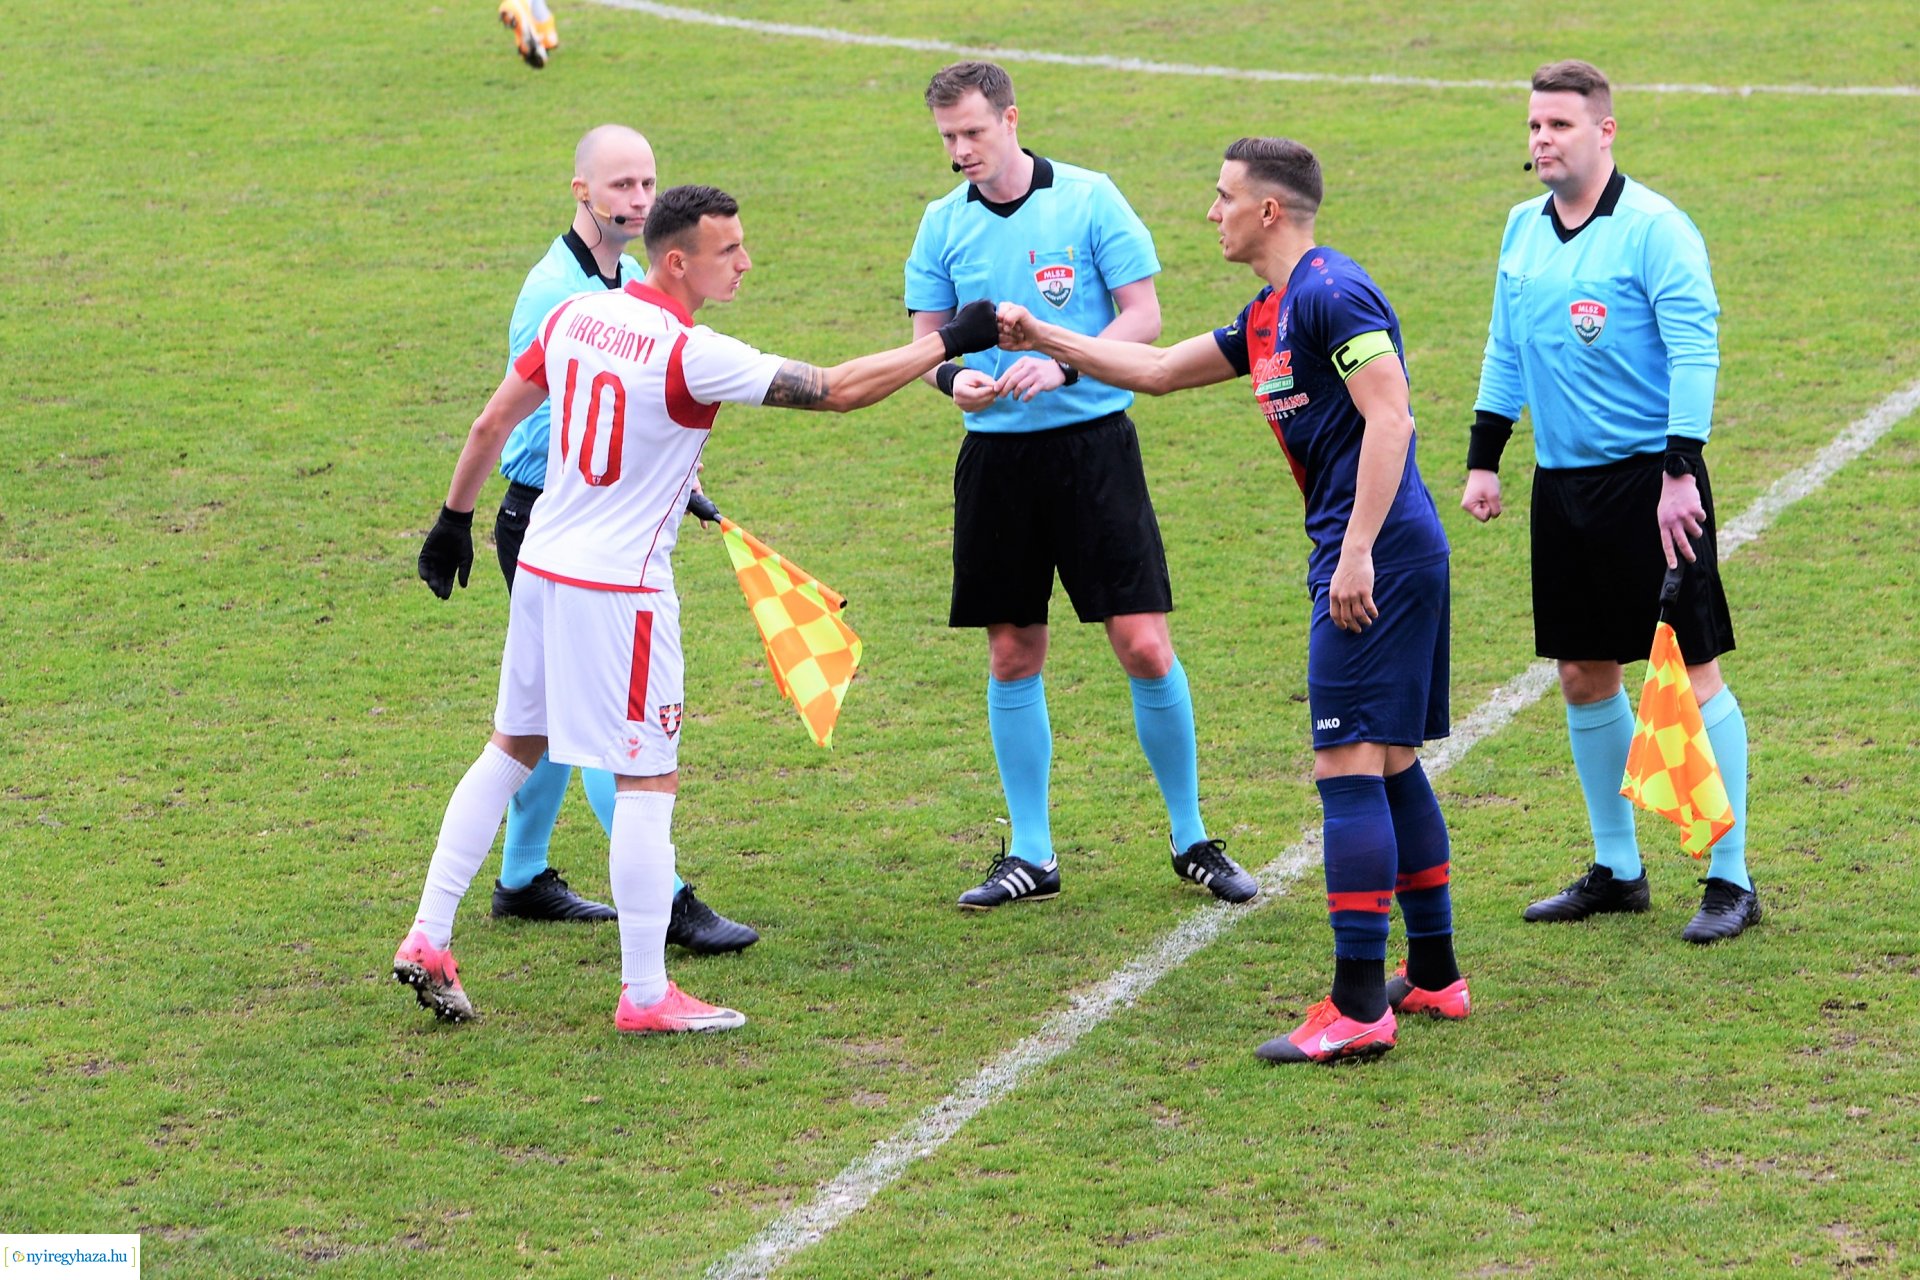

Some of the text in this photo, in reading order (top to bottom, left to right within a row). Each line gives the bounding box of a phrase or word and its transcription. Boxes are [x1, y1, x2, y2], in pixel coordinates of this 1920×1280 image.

[1043, 269, 1067, 280] MLSZ
[1577, 304, 1600, 314] MLSZ
[565, 313, 656, 365] HARSÁNYI
[1335, 345, 1359, 373] C
[561, 358, 626, 487] 10
[1316, 717, 1341, 731] JAKO
